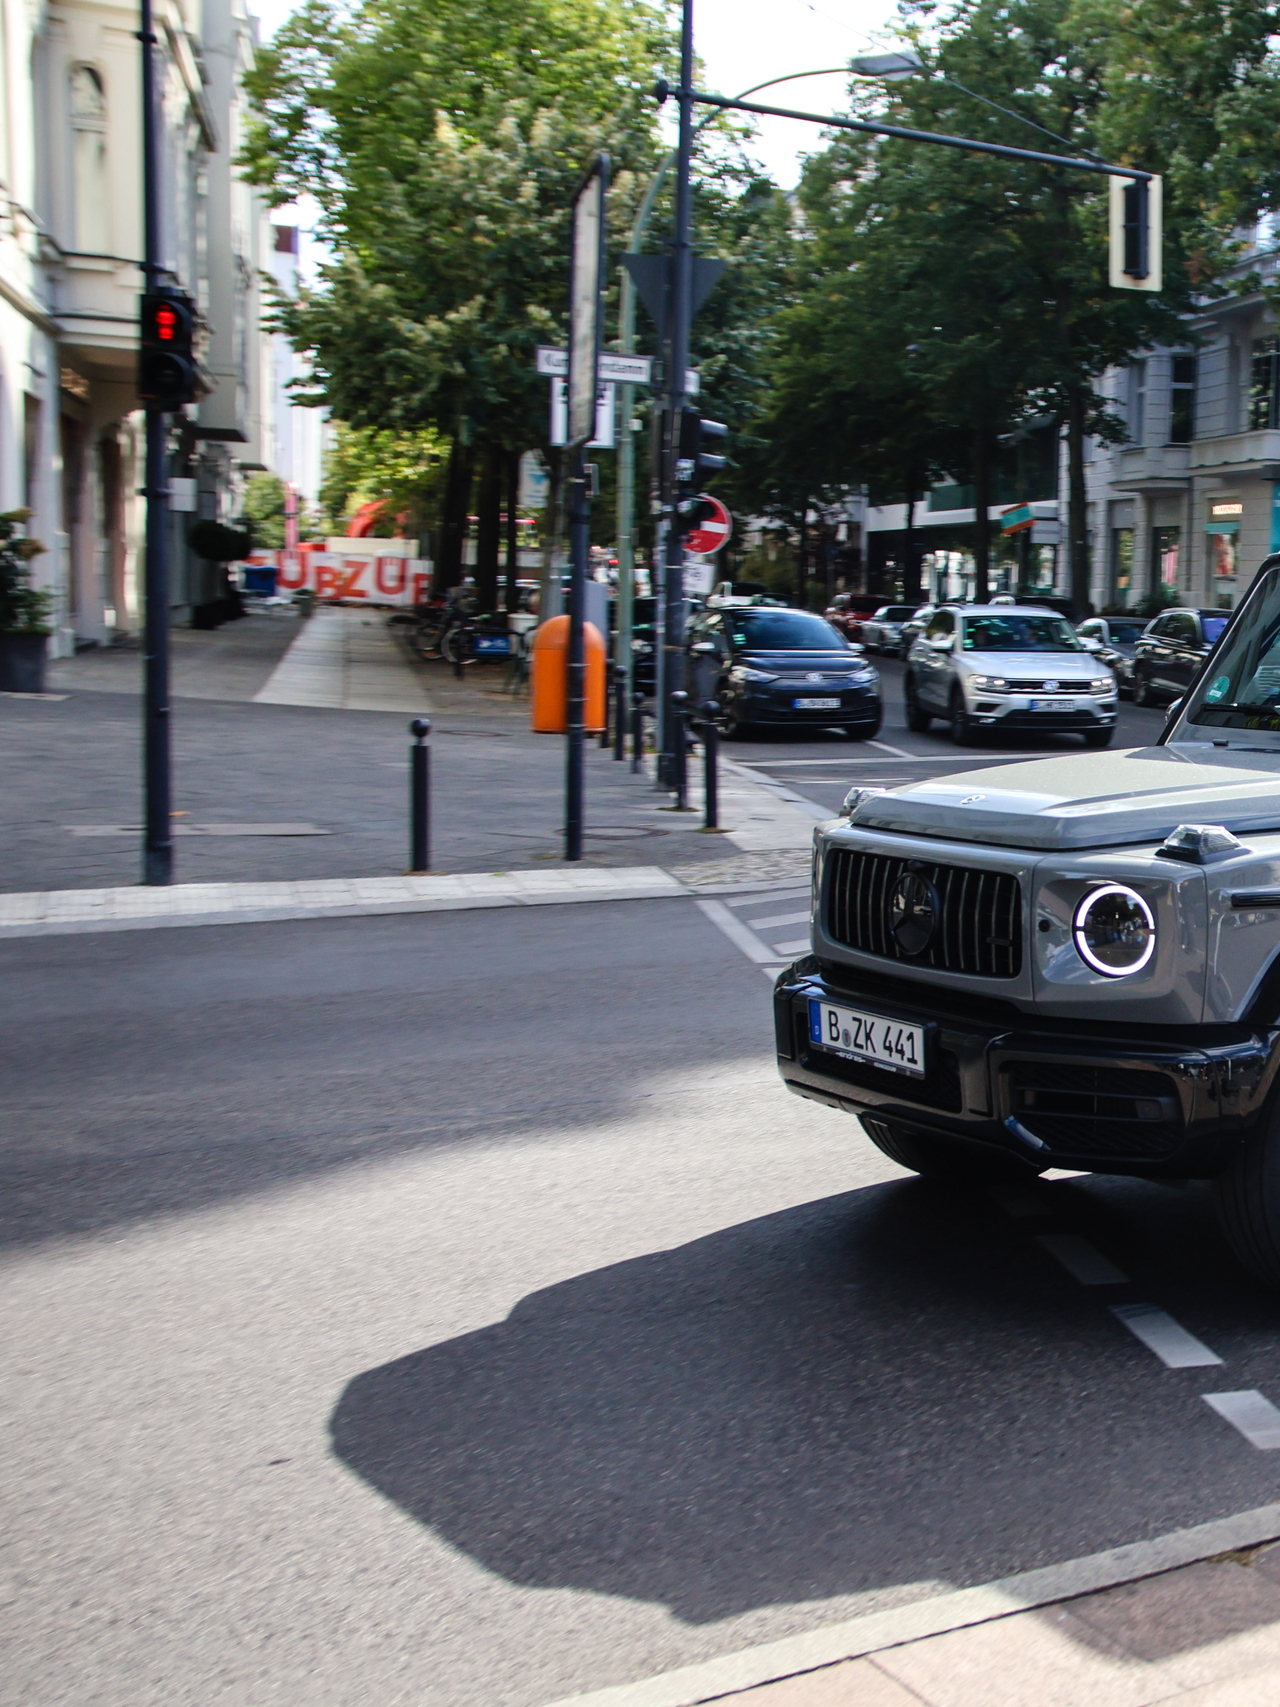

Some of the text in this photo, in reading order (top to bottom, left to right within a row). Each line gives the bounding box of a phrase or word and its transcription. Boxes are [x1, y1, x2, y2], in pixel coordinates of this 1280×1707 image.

[828, 1010, 918, 1065] B ZK 441
